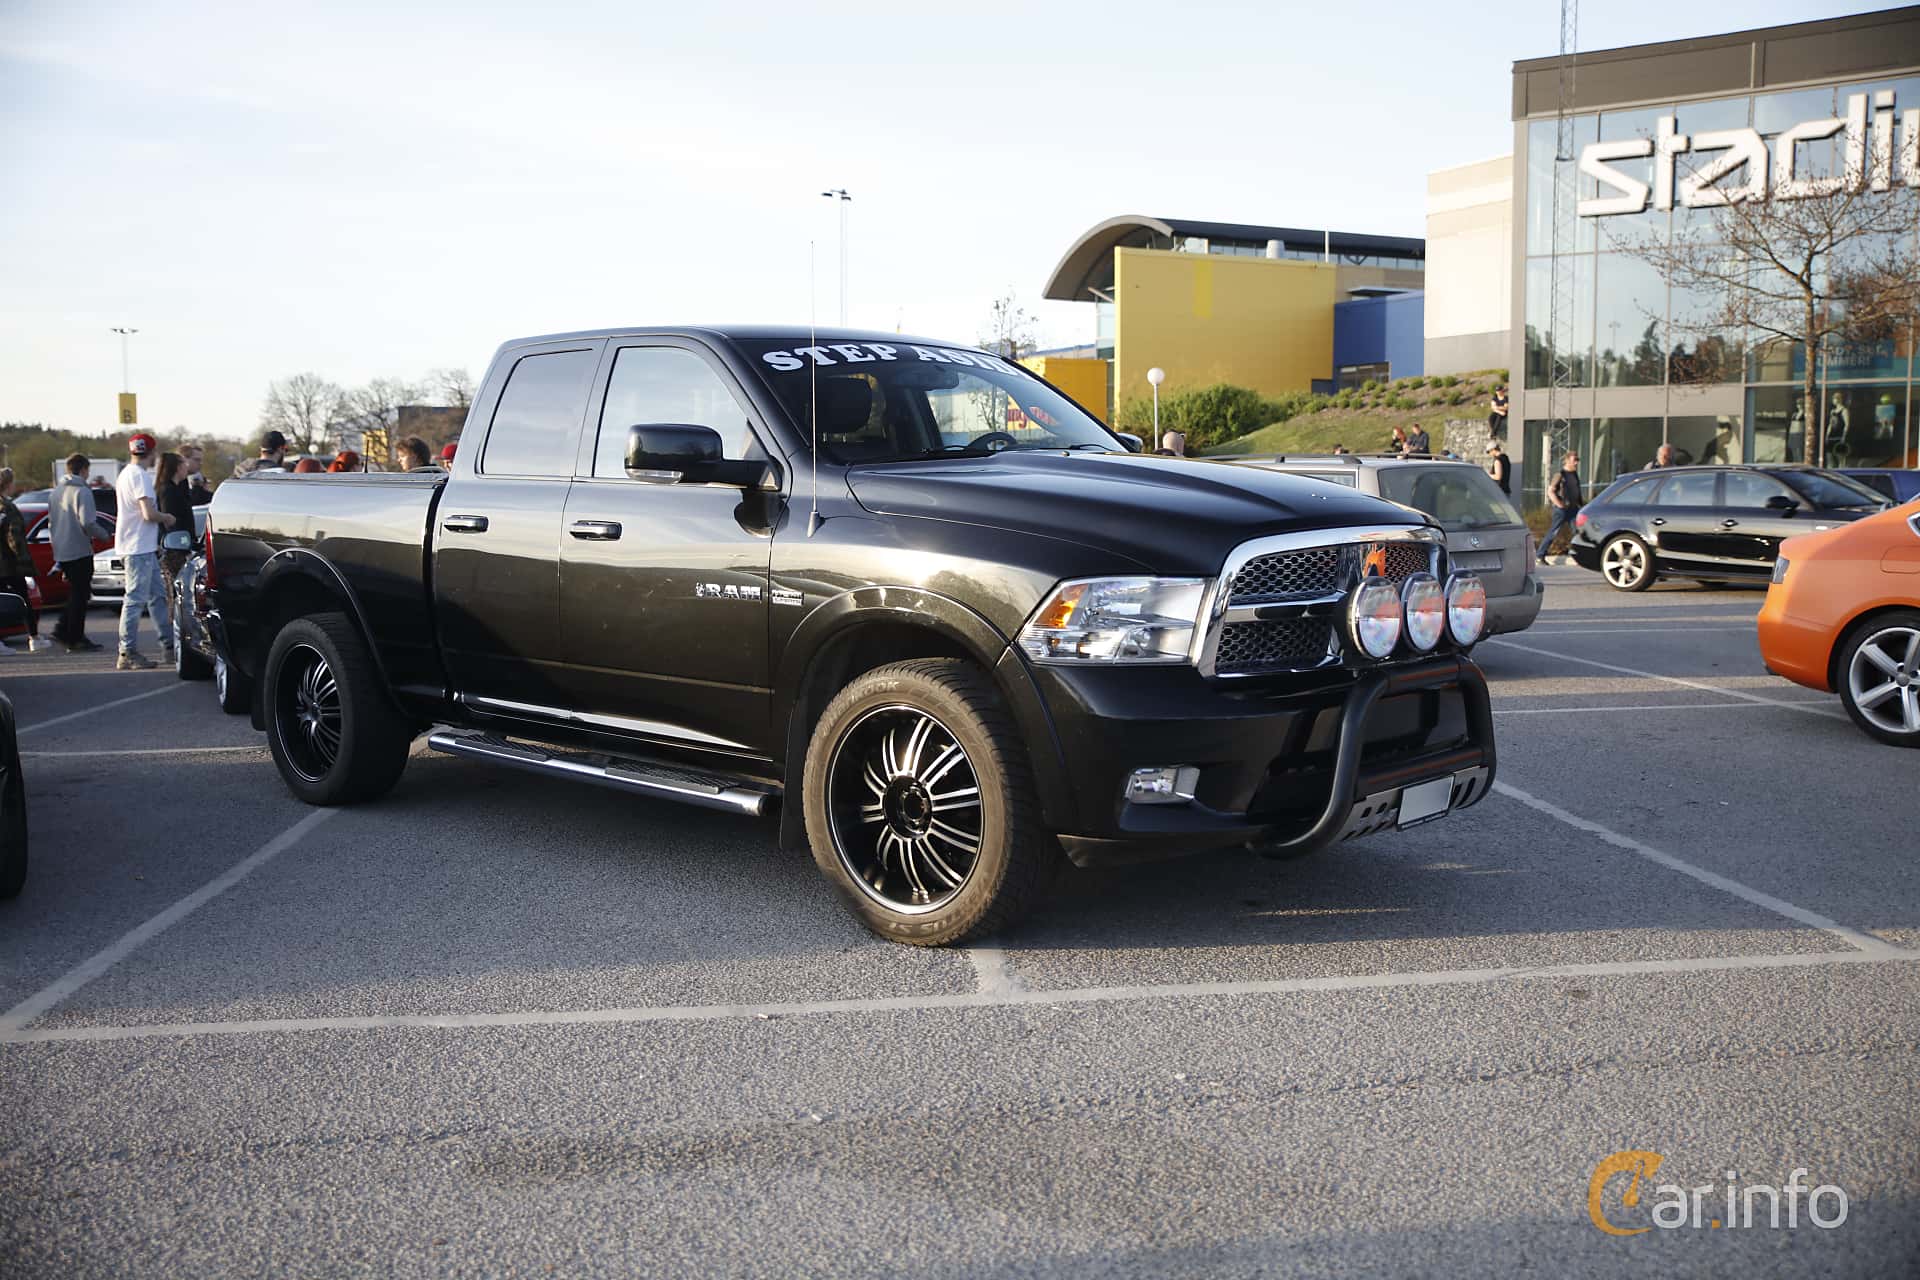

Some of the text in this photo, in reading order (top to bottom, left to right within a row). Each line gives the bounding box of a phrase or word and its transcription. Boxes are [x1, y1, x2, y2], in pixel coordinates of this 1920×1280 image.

[1577, 90, 1920, 217] stadi
[762, 343, 898, 371] STEP
[705, 583, 761, 600] RAM
